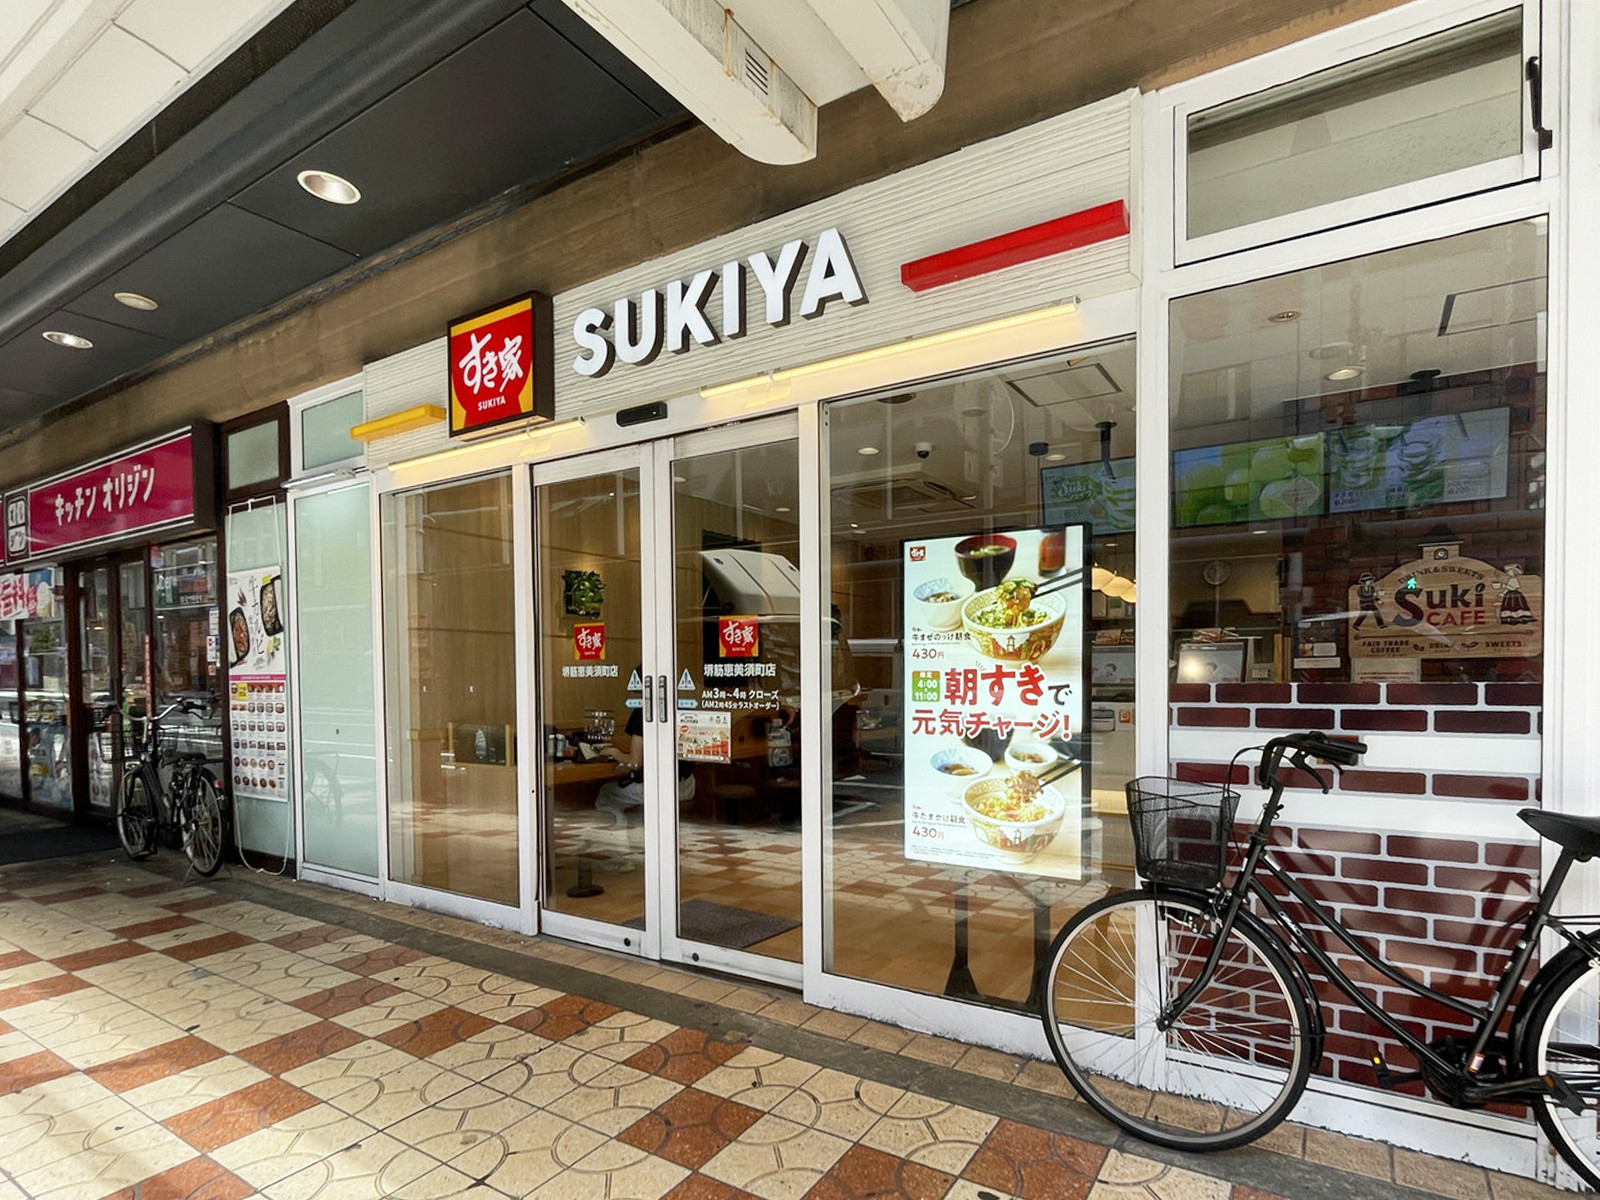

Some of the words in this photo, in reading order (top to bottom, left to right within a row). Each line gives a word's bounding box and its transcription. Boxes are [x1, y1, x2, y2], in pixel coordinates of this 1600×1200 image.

[572, 227, 868, 378] SUKIYA
[459, 333, 523, 395] すき家
[477, 395, 506, 411] SUKIYA
[55, 486, 97, 526] キッチン
[102, 464, 155, 513] オリジン
[1392, 582, 1486, 627] Suki
[1426, 610, 1486, 626] CAFE
[577, 628, 602, 650] すき家
[723, 620, 754, 646] すき家
[748, 689, 779, 699] クローズ
[944, 664, 1072, 706] 朝すきで
[912, 709, 1070, 739] 元気チャージ!
